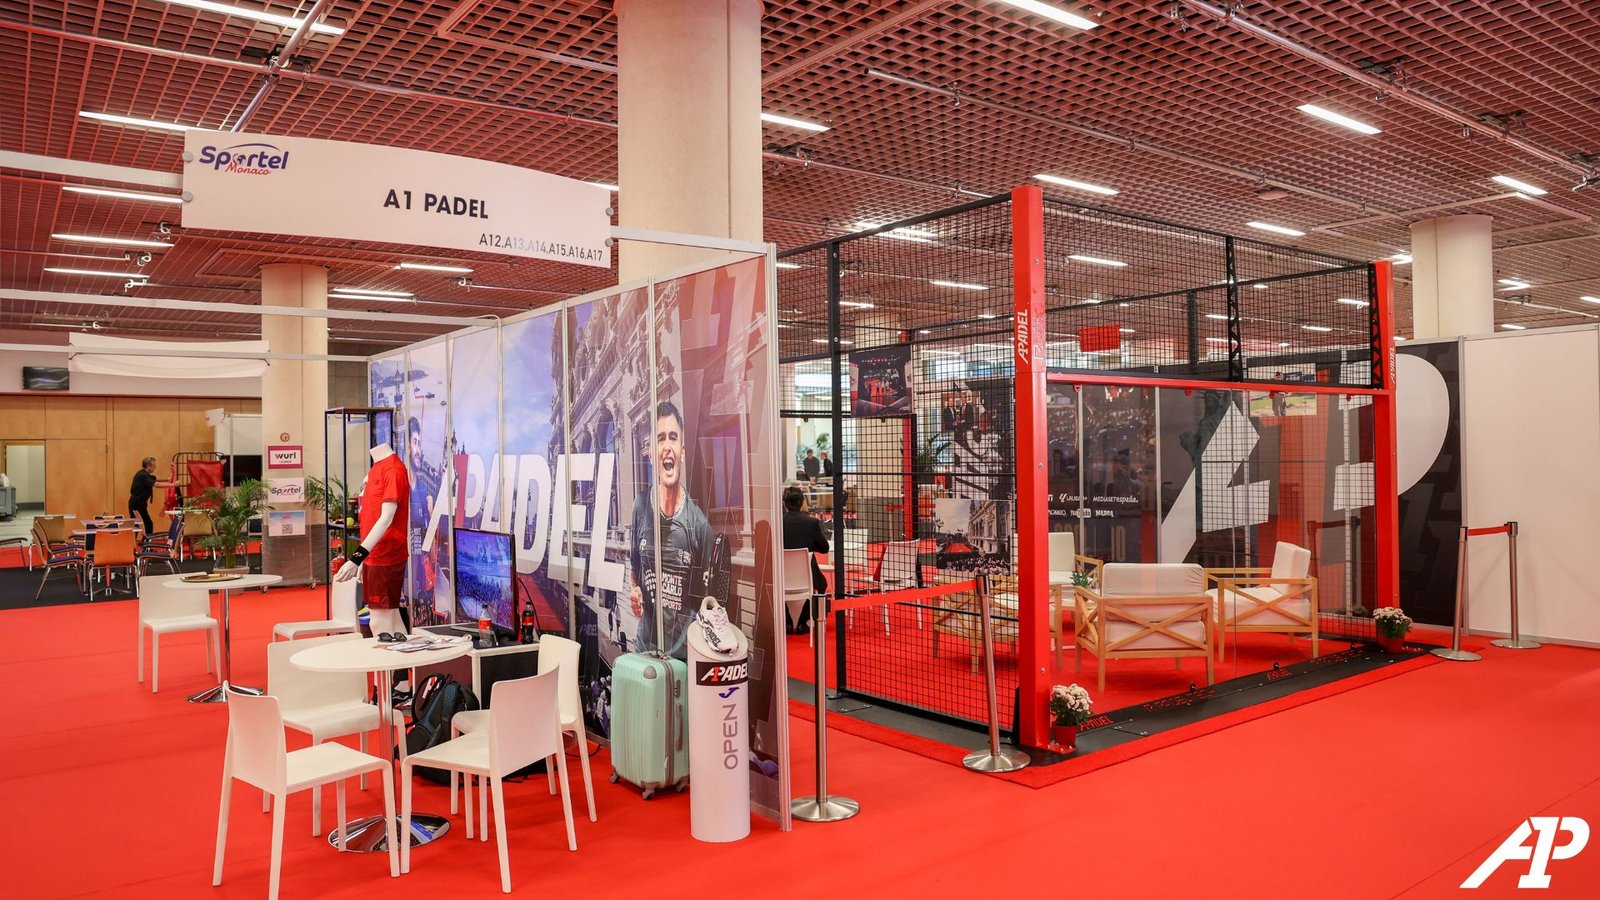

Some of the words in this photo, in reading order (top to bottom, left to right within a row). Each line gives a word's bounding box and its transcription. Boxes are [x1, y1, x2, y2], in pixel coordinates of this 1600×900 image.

[199, 145, 289, 170] Sportel
[225, 162, 271, 175] Monaco
[383, 189, 412, 210] A1
[424, 193, 489, 219] PADEL
[722, 703, 738, 770] OPEN
